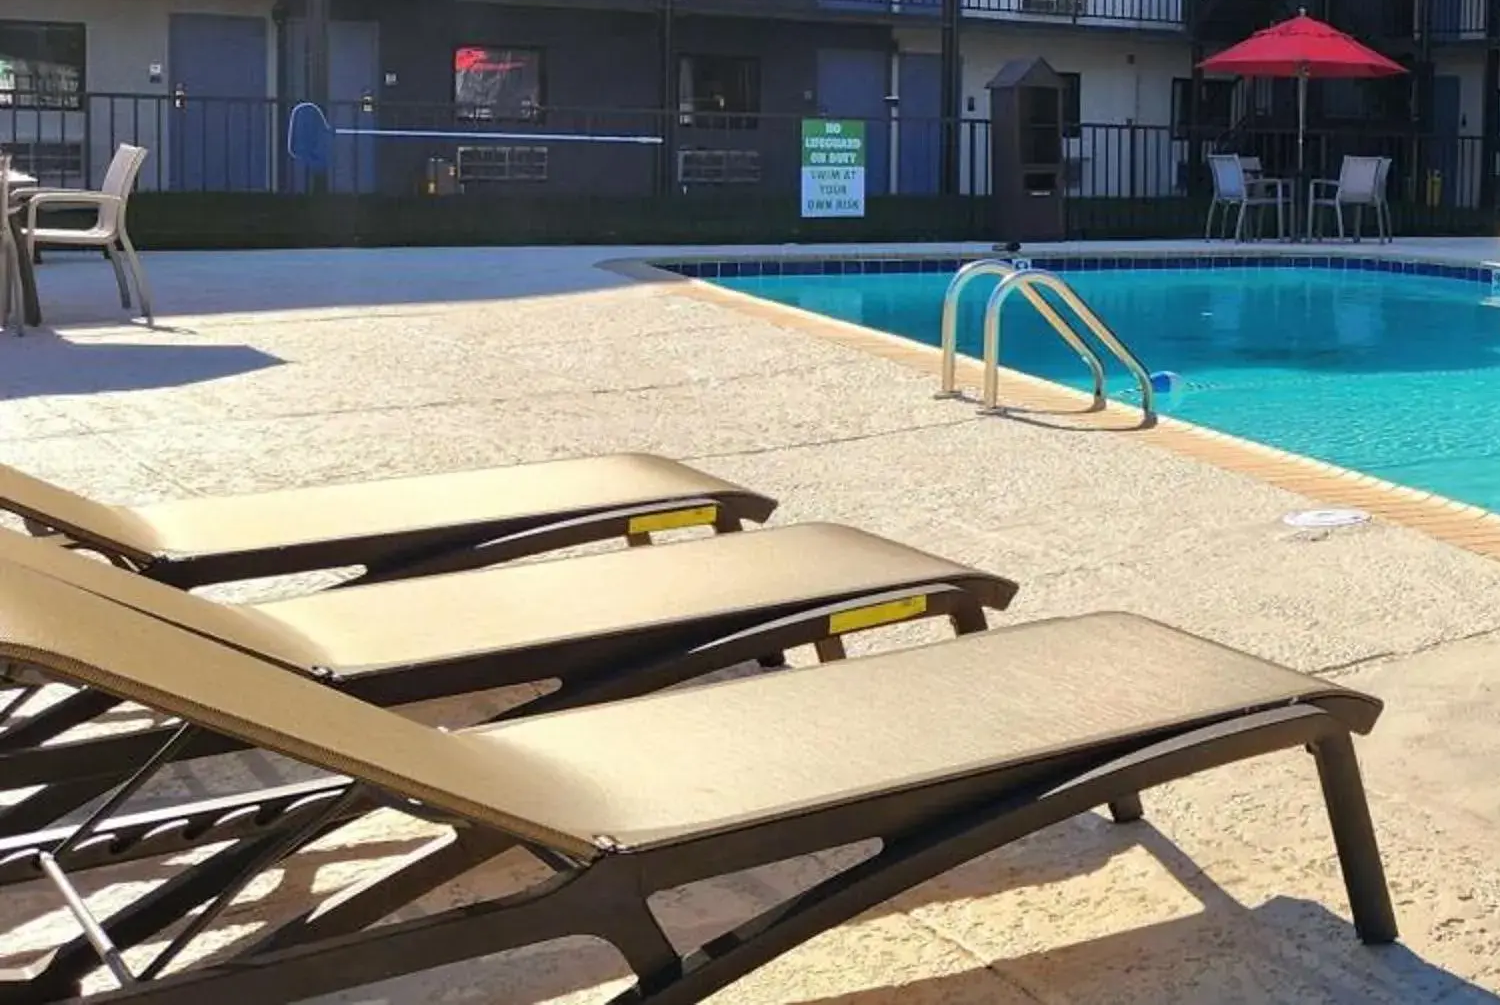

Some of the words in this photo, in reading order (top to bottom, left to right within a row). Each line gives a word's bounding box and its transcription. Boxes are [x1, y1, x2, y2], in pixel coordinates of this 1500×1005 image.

[825, 122, 842, 134] NO
[805, 137, 861, 149] LIFEGUARD
[810, 152, 827, 164] ON
[829, 152, 857, 164] DUTY
[843, 169, 857, 180] AT
[819, 184, 847, 195] YOUR
[807, 199, 832, 211] OWN
[836, 200, 860, 211] RISK
